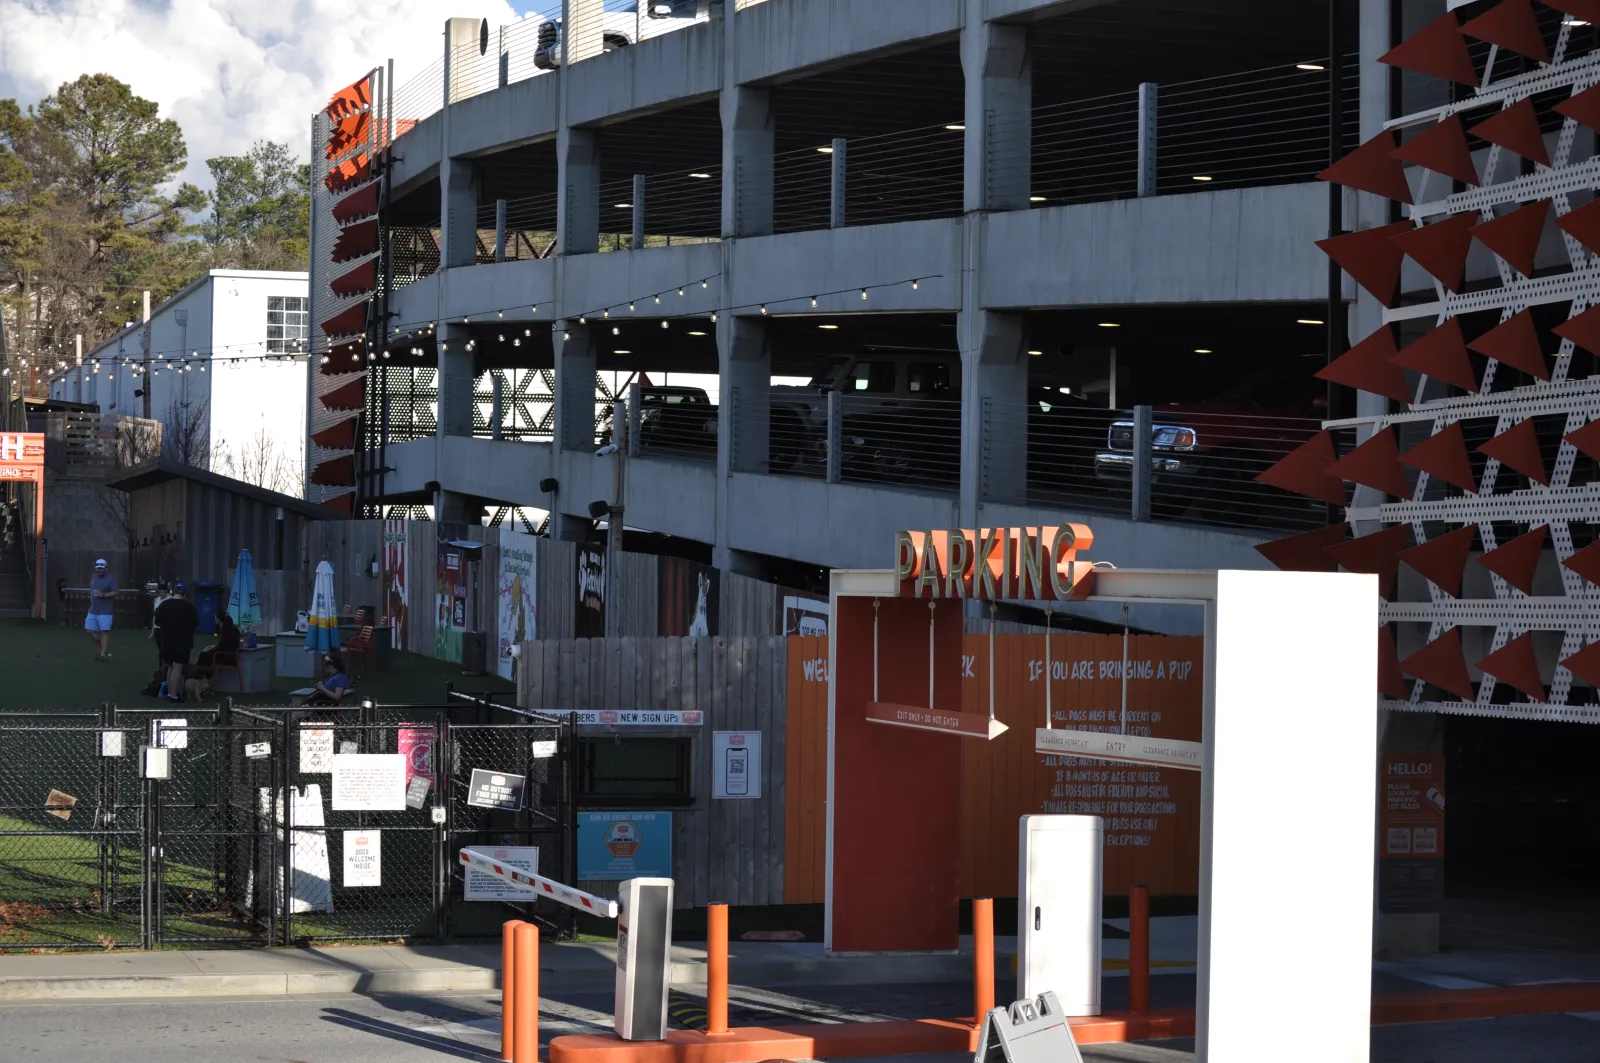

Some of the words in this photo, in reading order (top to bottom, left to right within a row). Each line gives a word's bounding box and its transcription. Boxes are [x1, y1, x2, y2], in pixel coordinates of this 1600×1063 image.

[894, 523, 1093, 600] PARKING
[803, 659, 830, 682] WEL
[961, 655, 975, 678] RK
[1028, 660, 1042, 681] IF
[1050, 661, 1068, 680] OU
[1071, 660, 1094, 680] ARE
[1100, 660, 1154, 680] BRINGING
[1156, 661, 1166, 680] A
[1169, 660, 1192, 681] PUP
[558, 712, 595, 723] MEBERS
[620, 711, 637, 723] NEW
[642, 711, 661, 723] SIGN
[664, 712, 679, 723] UPs
[897, 710, 908, 720] EXIT
[908, 712, 920, 722] ONLY
[924, 714, 931, 723] DO
[933, 715, 941, 724] NOT
[943, 716, 959, 727] ENTER
[1069, 710, 1086, 721] DOGS
[1088, 710, 1106, 721] MUST
[1107, 711, 1116, 721] BE
[1151, 712, 1162, 722] ON
[1040, 736, 1064, 746] CLEARANCE
[1106, 742, 1126, 752] ENTRY
[1143, 746, 1169, 757] CLEARANCE
[1059, 757, 1077, 766] DOGS
[1387, 763, 1432, 775] HELLO!
[1056, 770, 1063, 782] IF
[1111, 772, 1126, 782] AGE
[490, 786, 513, 794] OUTSIDE
